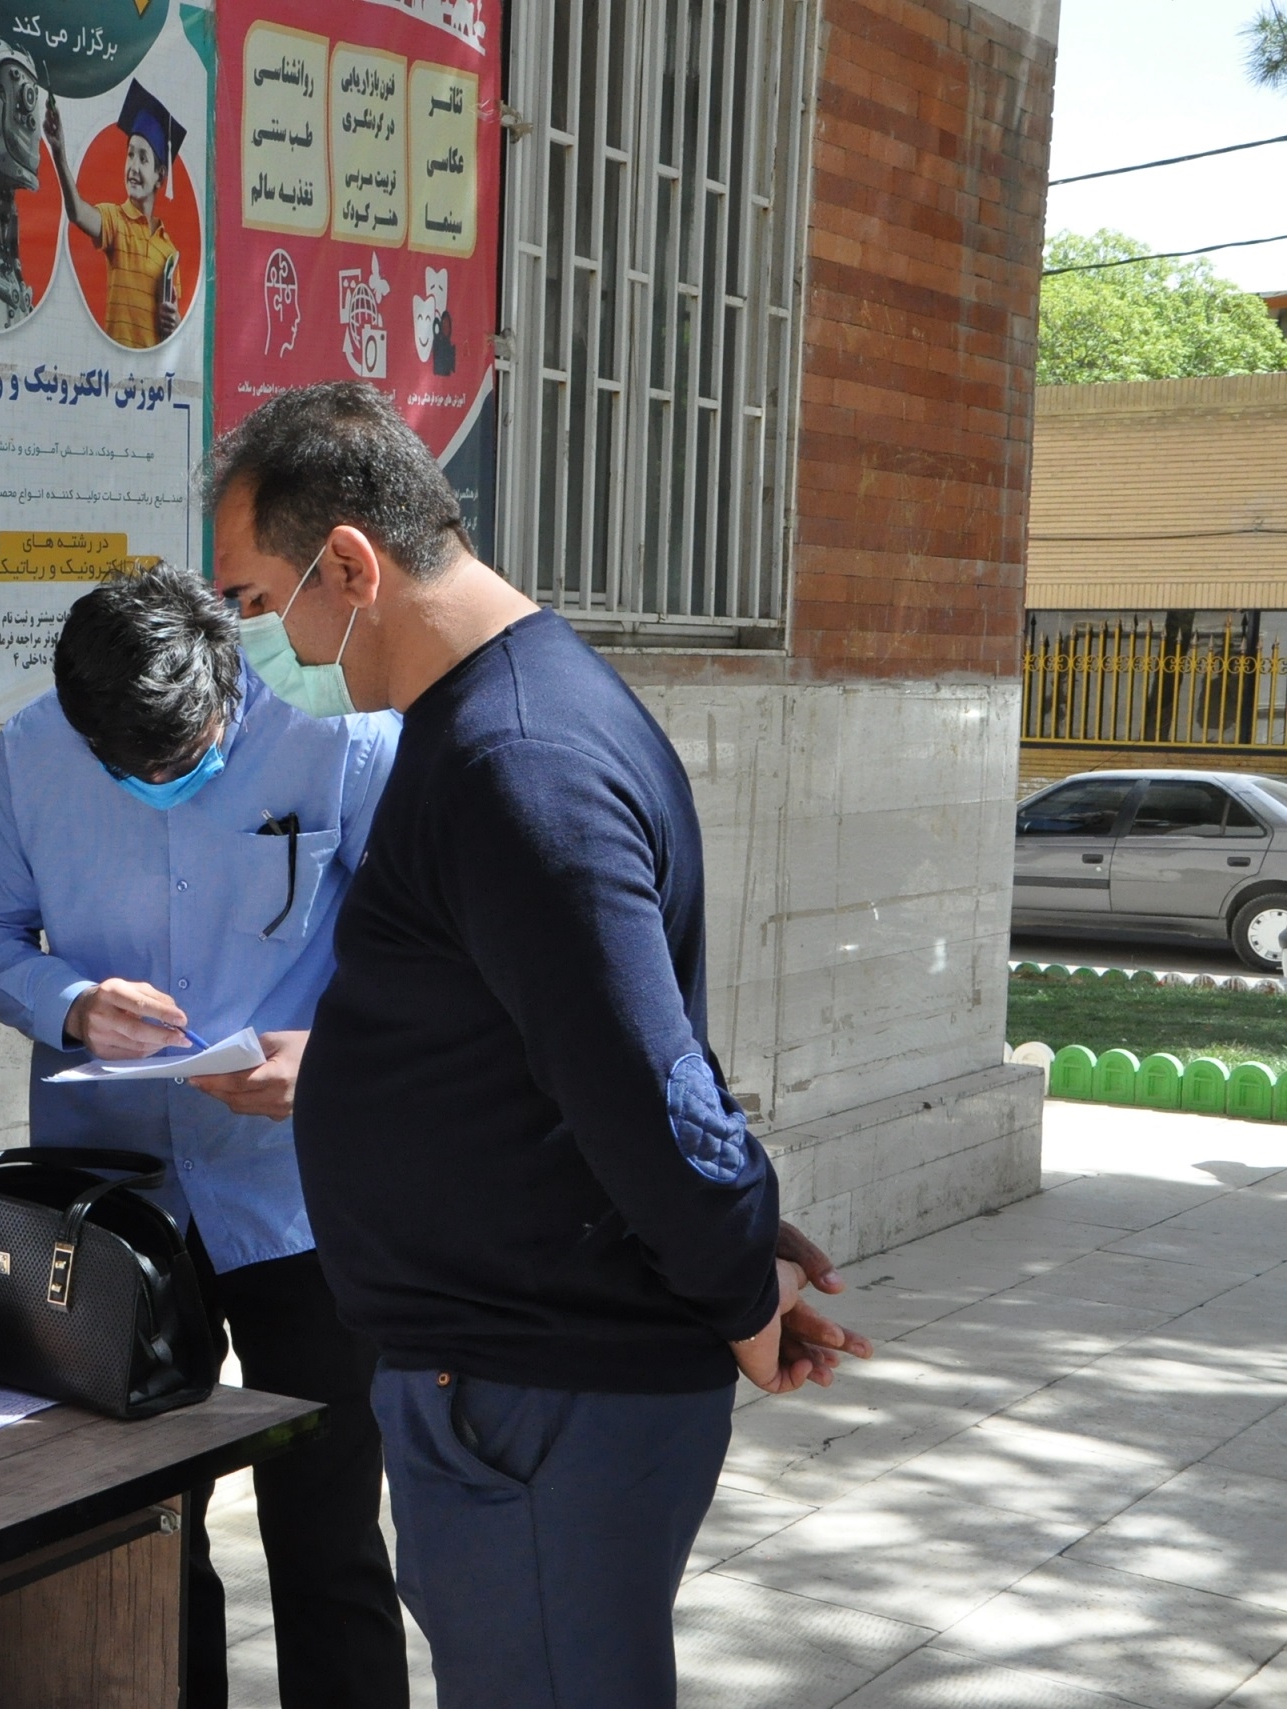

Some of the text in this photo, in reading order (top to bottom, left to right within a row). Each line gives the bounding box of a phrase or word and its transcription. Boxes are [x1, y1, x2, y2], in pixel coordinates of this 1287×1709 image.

[13, 15, 118, 60] برگزار می کند
[254, 56, 314, 98] روانشناسی
[341, 66, 395, 101] فنون بازاریابی
[428, 86, 463, 117] تئاتر
[342, 108, 395, 141] در گردشگری
[252, 119, 313, 152] طب سنتی
[426, 146, 464, 178] عکاسی
[345, 168, 397, 196] تربیت مربی
[251, 172, 314, 211] تغذیه سالم
[342, 199, 398, 231] هنر کودک
[425, 202, 463, 241] سینما
[9, 373, 19, 401] و
[24, 364, 109, 405] الکترونیک
[115, 372, 175, 411] آموزش
[17, 445, 23, 455] و
[24, 442, 59, 457] آموزی
[61, 445, 94, 458] دانش
[131, 448, 155, 461] مهد
[18, 488, 44, 505] انواع
[46, 489, 74, 501] کننده
[76, 490, 101, 503] تولید
[123, 490, 153, 506] رباتیک
[154, 493, 183, 508] صنایع
[22, 534, 109, 554] در رشته های
[49, 563, 56, 580] و
[2, 611, 13, 628] نام
[14, 609, 28, 627] ثبت
[30, 615, 34, 628] و
[36, 611, 55, 627] بیشتر
[15, 632, 41, 648] مراجعه
[13, 652, 19, 668] ۴
[21, 653, 48, 670] داخلی
